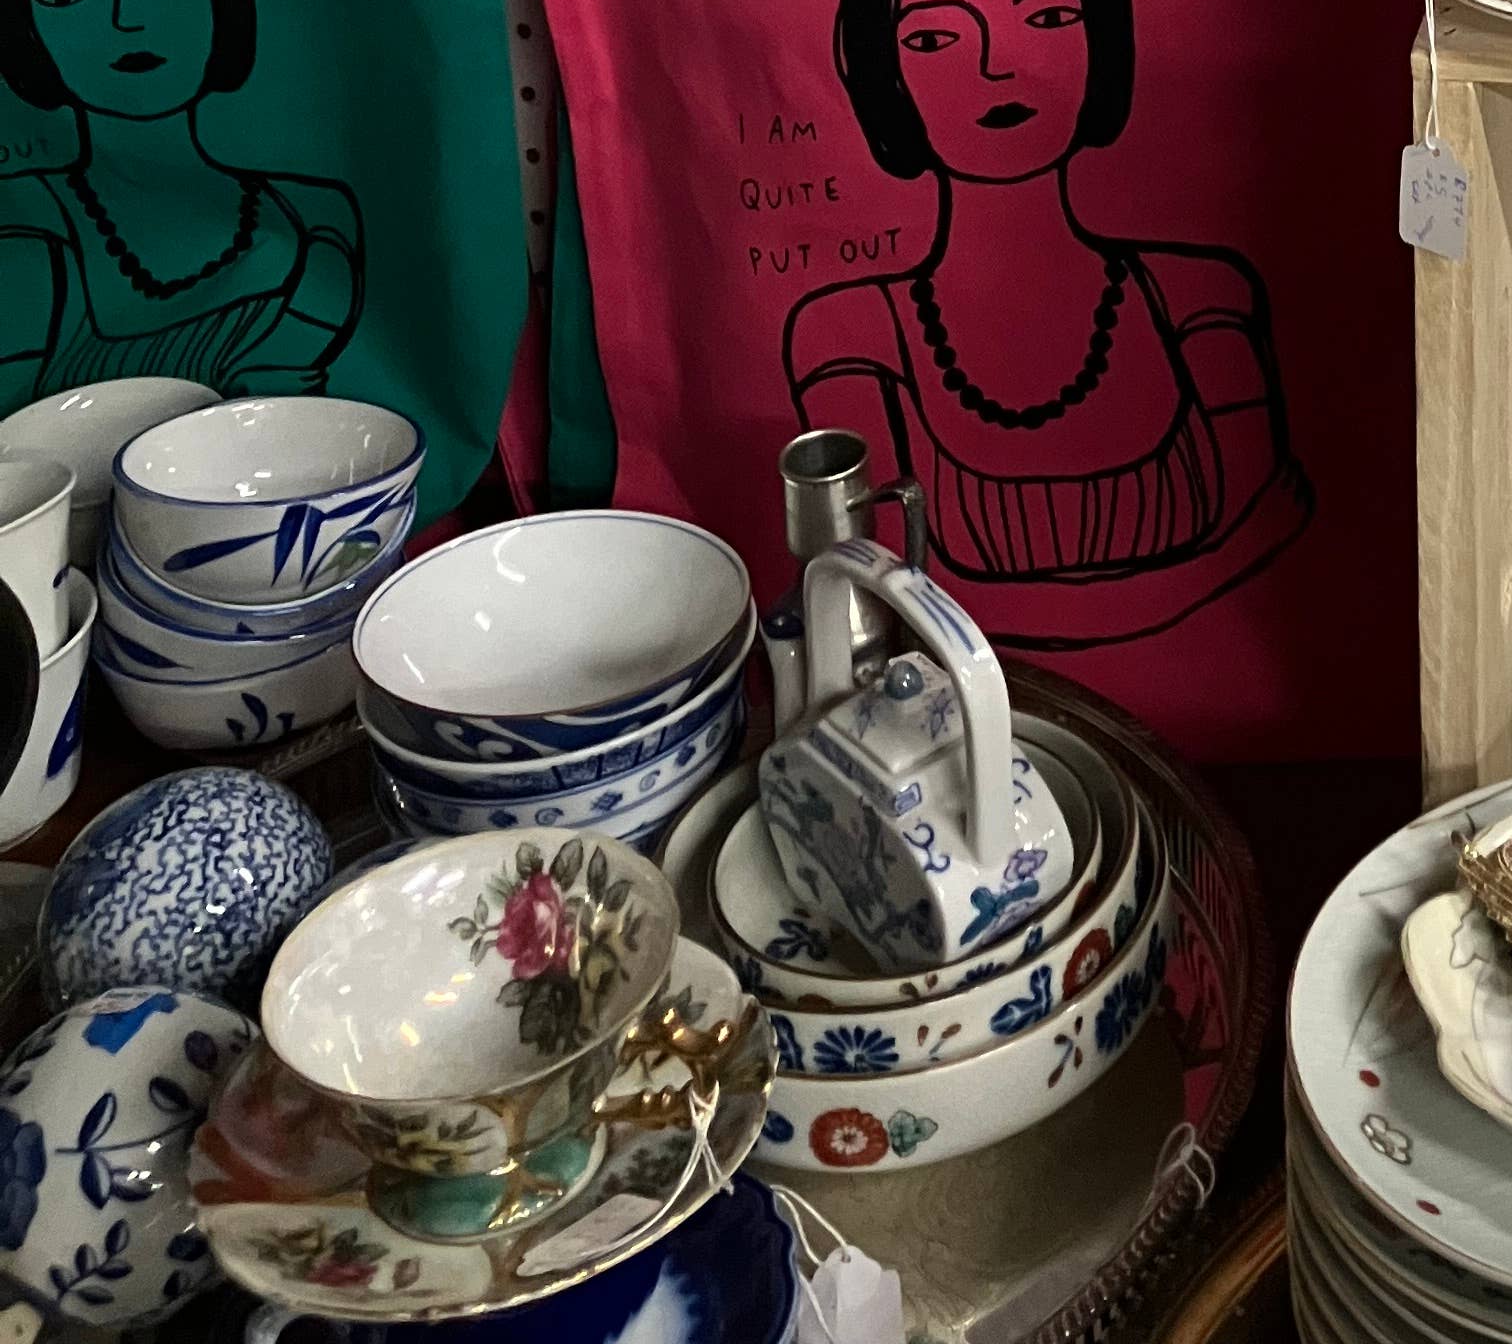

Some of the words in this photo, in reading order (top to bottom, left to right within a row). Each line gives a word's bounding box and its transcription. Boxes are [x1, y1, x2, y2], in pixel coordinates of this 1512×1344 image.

[738, 113, 746, 145] I
[767, 114, 818, 145] AM
[739, 176, 841, 212] QUITE
[748, 243, 811, 277] PUT
[839, 227, 902, 264] OUT
